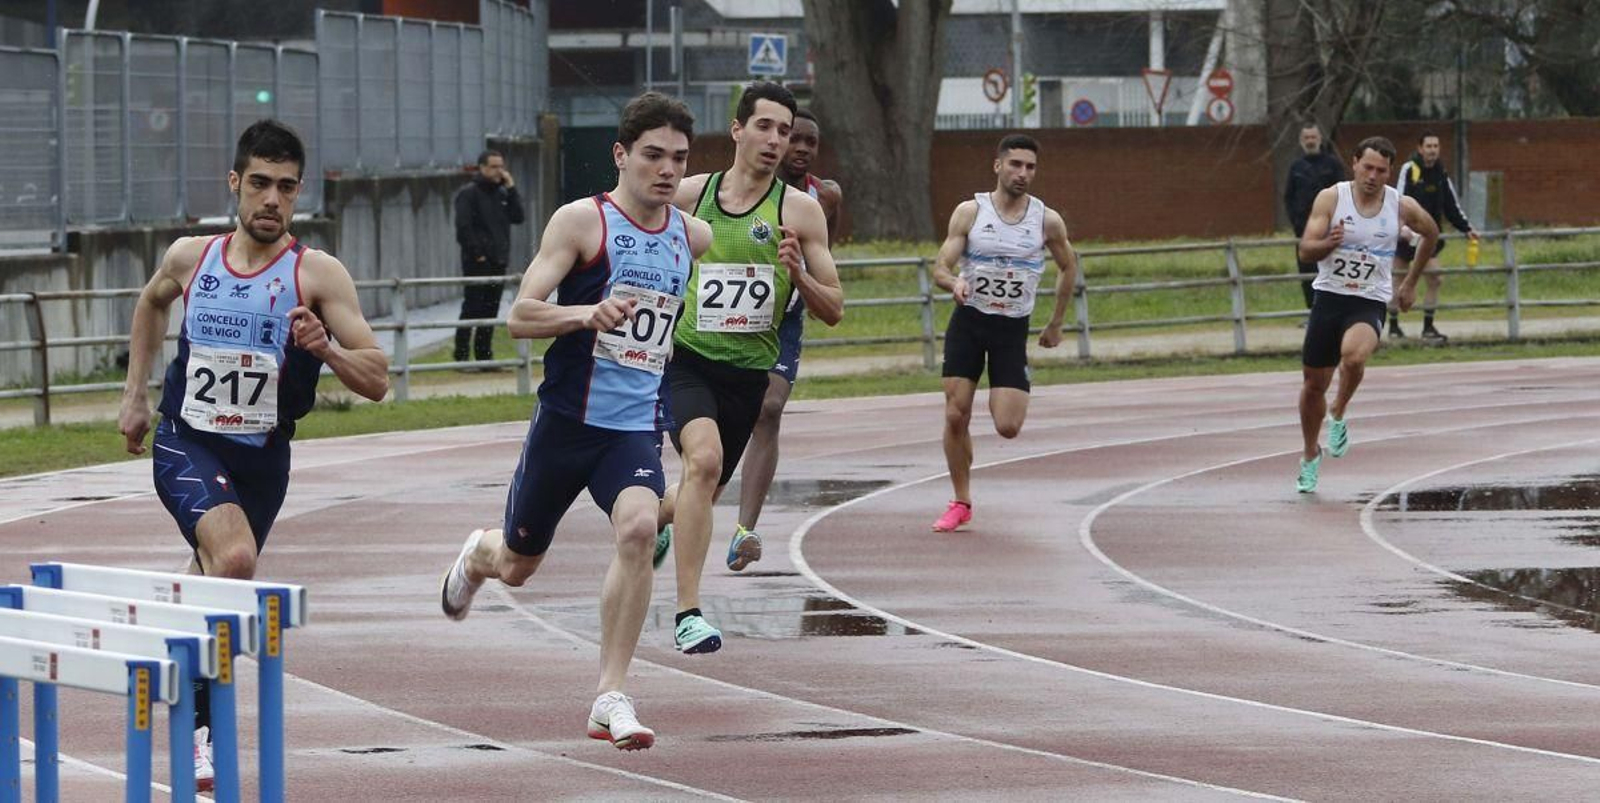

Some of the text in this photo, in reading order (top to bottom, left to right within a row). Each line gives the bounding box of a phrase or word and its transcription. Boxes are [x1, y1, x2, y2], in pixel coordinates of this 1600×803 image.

[622, 269, 662, 282] CONCELLO
[1333, 258, 1376, 280] 237
[702, 279, 770, 309] 279
[975, 276, 1024, 298] 233
[196, 312, 249, 328] CONCELLO
[606, 308, 674, 346] 07
[201, 325, 241, 339] DE VIGO
[194, 366, 268, 406] 217
